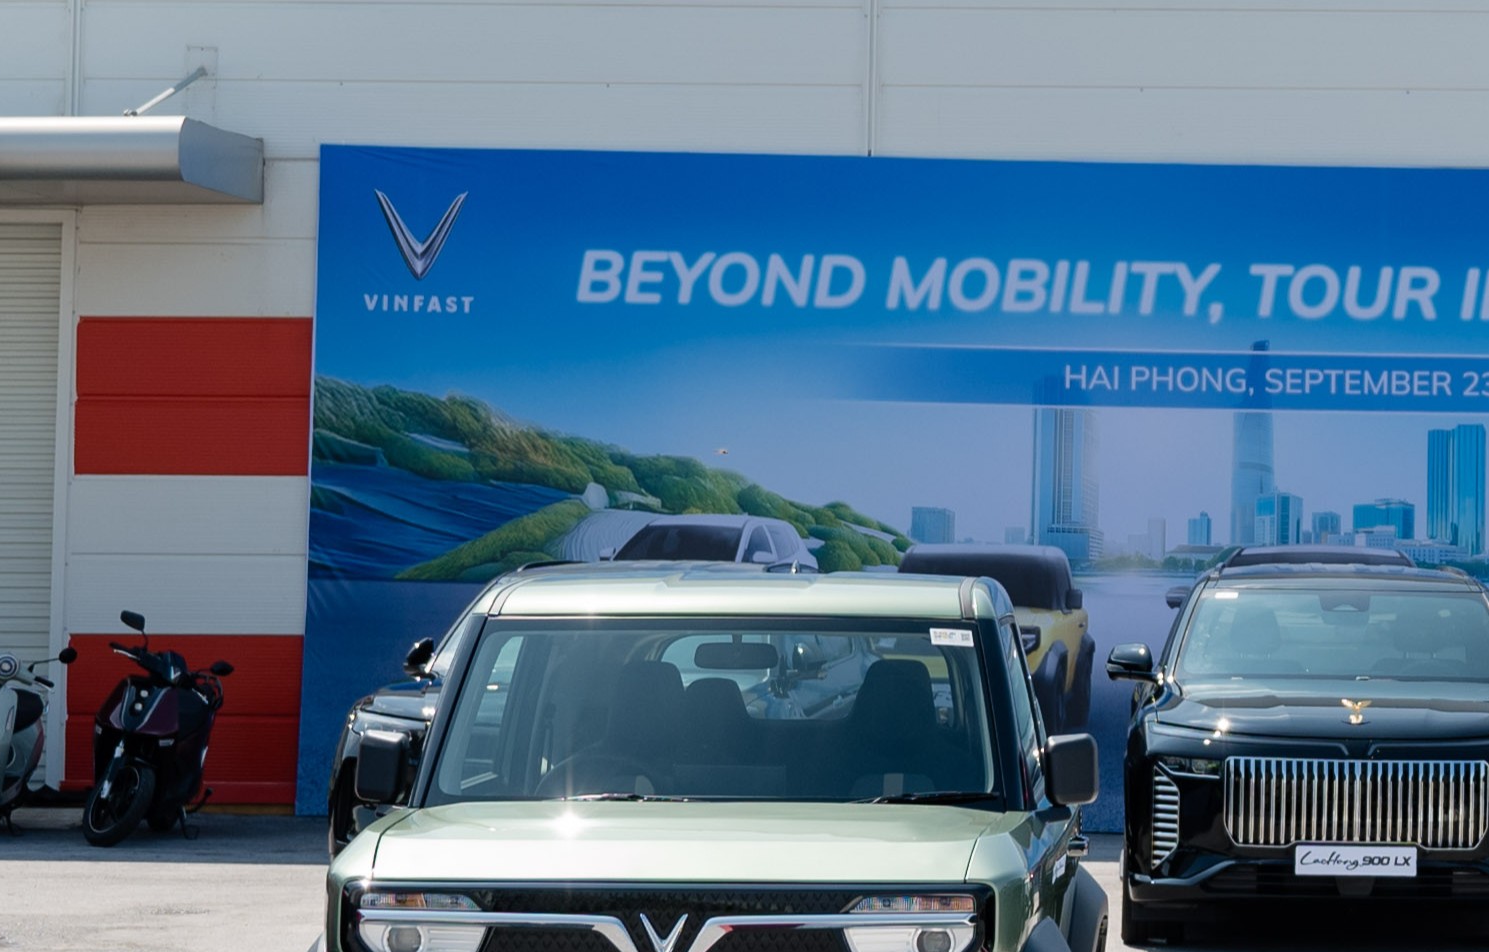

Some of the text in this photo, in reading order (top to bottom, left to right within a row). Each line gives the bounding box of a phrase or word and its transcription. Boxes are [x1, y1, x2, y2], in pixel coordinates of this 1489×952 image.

[576, 249, 1489, 324] BEYOND MOBILITY, TOUR I
[363, 293, 474, 314] VINFAST
[1064, 364, 1120, 391] HAI
[1131, 366, 1255, 397] PHONG,
[1264, 368, 1452, 396] SEPTEMBER
[1361, 856, 1390, 867] 900
[1393, 856, 1412, 867] LX
